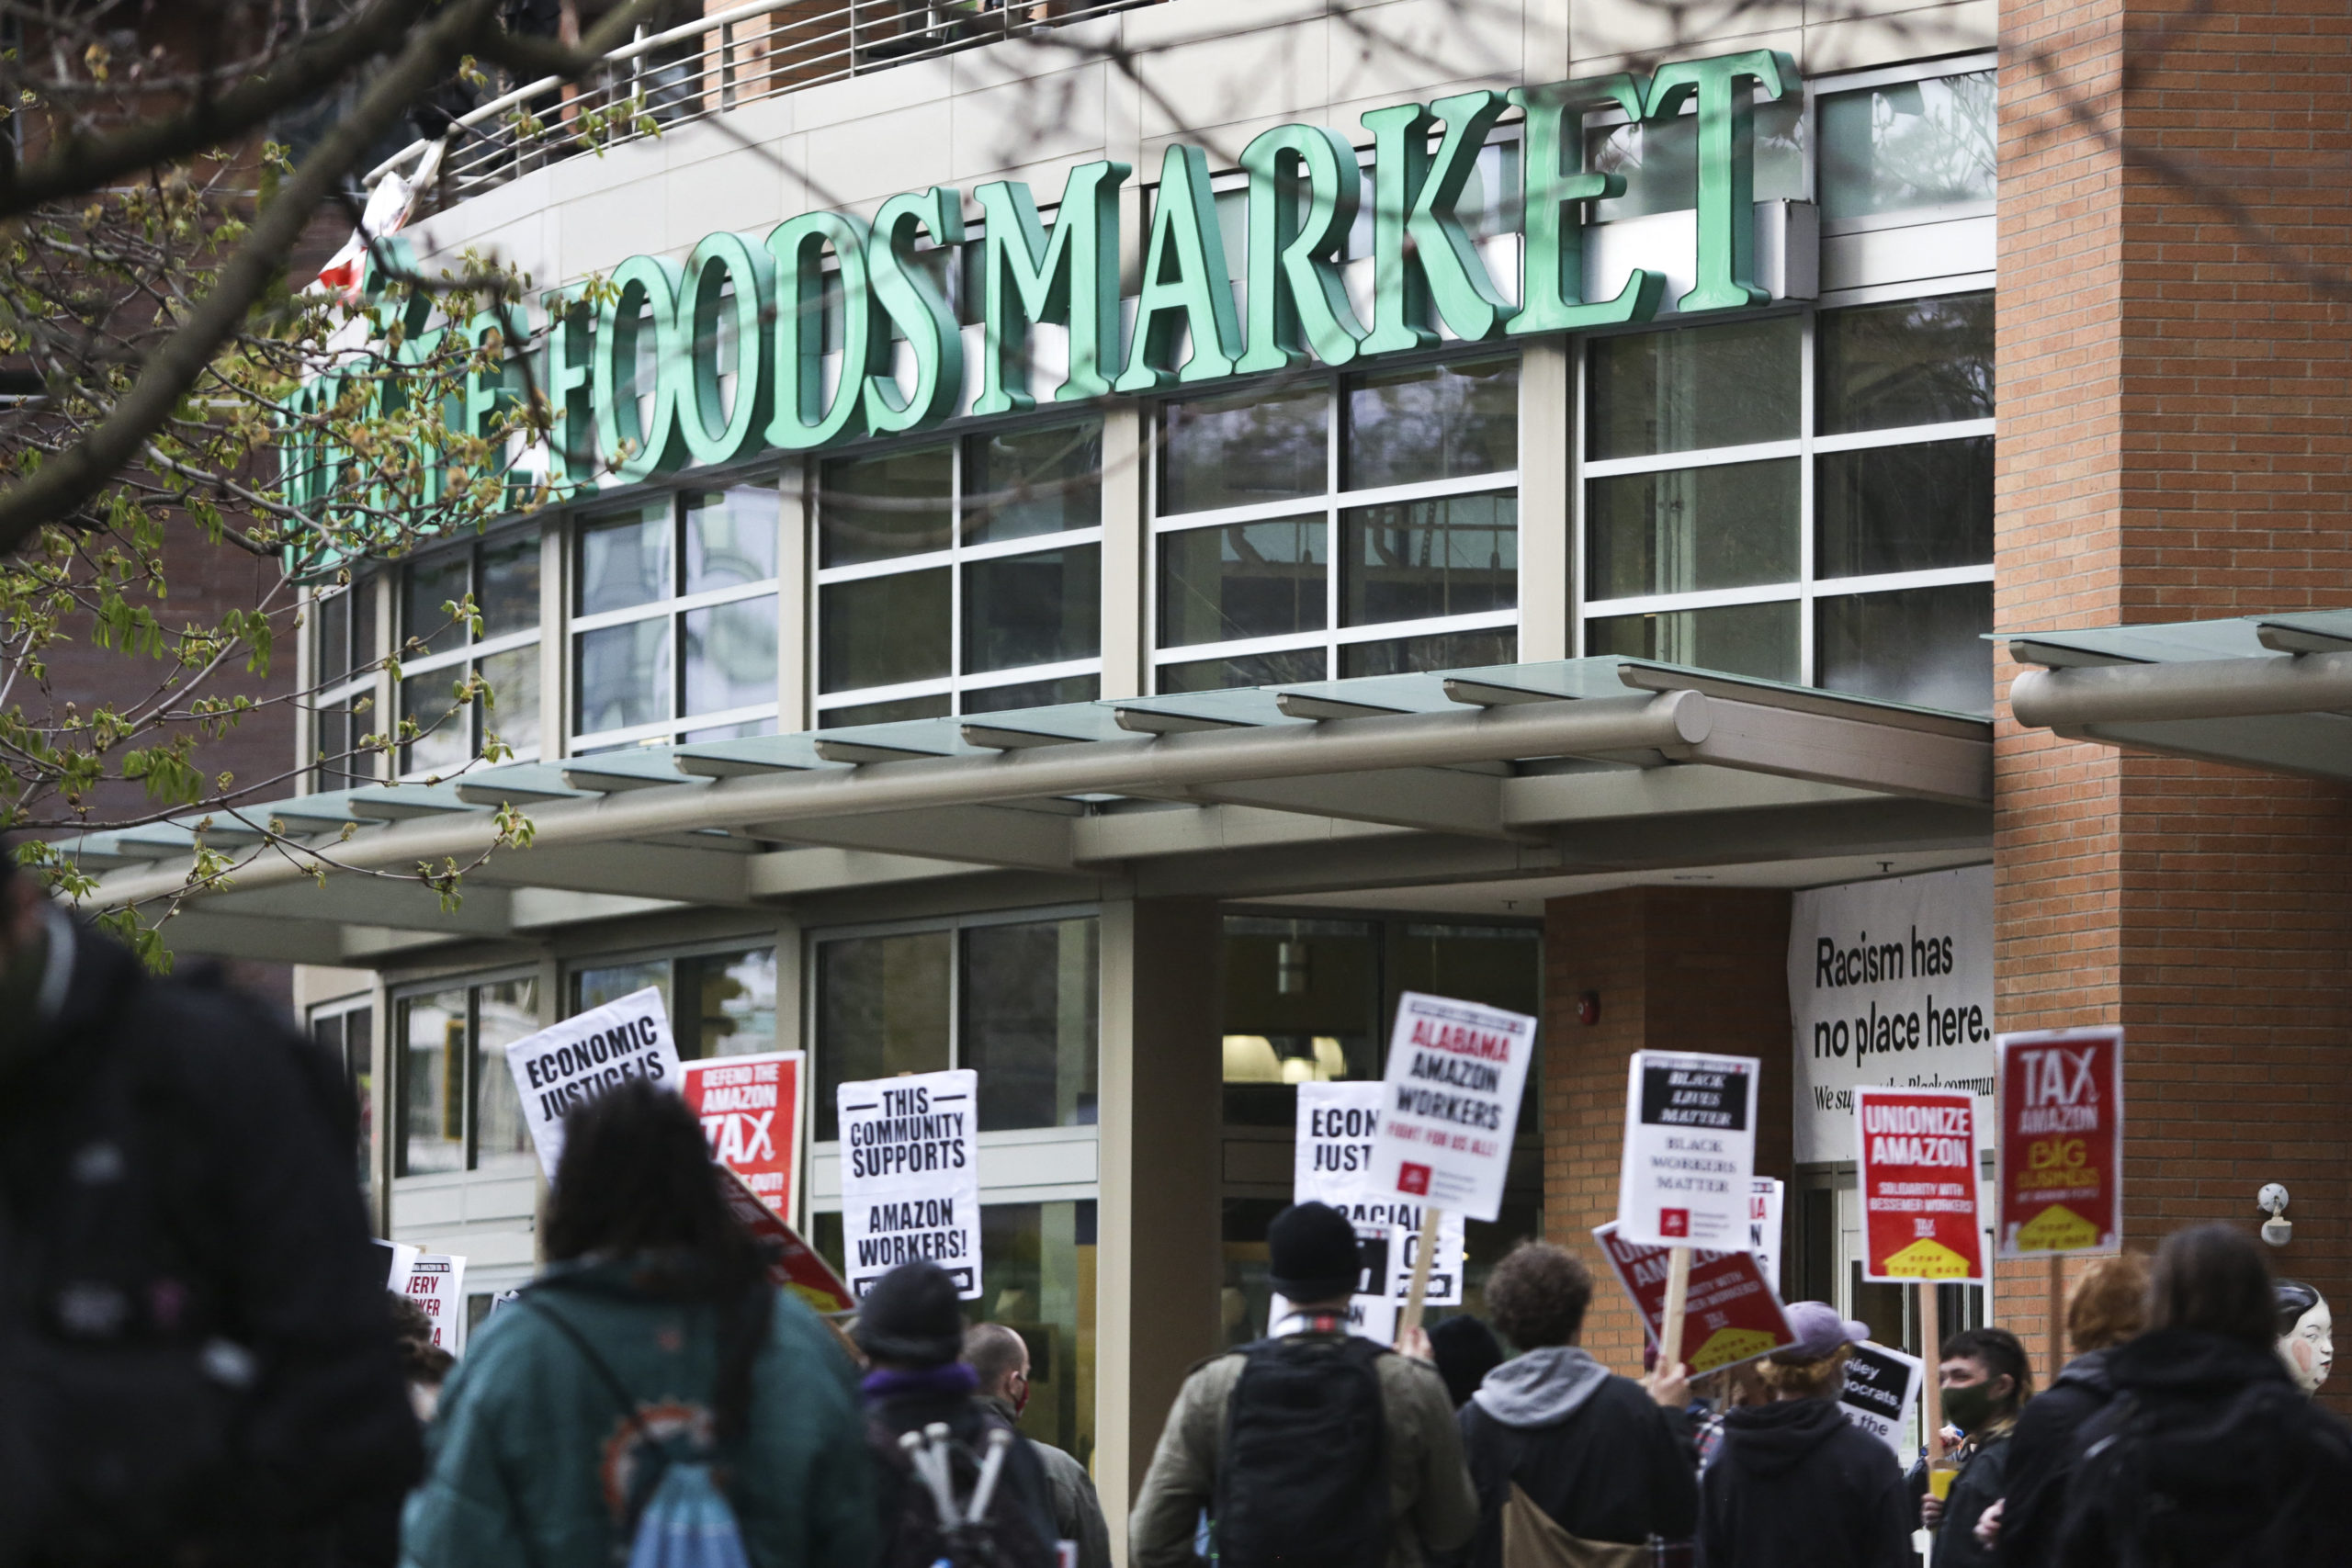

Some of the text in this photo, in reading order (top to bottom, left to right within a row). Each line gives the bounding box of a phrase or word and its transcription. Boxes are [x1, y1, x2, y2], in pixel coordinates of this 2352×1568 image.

[540, 186, 963, 503] FOODS
[972, 49, 1799, 416] MARKET
[1815, 924, 1953, 988] Racism has
[1410, 1019, 1511, 1064] ALABAMA
[1814, 994, 1990, 1068] no place here.
[526, 1015, 658, 1089] ECONOMIC
[701, 1063, 780, 1088] DEFEND THE
[1410, 1052, 1503, 1093] AMAZON
[2020, 1046, 2100, 1107] TAX
[701, 1084, 777, 1113] AMAZON
[882, 1087, 929, 1117] THIS
[1396, 1086, 1503, 1131] WORKERS
[1814, 1085, 1833, 1111] We
[699, 1110, 775, 1164] TAX
[851, 1112, 964, 1147] COMMUNITY
[1864, 1105, 1970, 1136] UNIONIZE
[2018, 1105, 2098, 1134] AMAZON
[853, 1138, 965, 1178] SUPPORTS
[1666, 1137, 1723, 1153] BLACK
[1871, 1136, 1967, 1168] AMAZON
[2029, 1137, 2087, 1170] BIG
[1650, 1156, 1736, 1174] WORKERS
[1656, 1177, 1729, 1193] MATTER
[870, 1198, 953, 1234] AMAZON
[858, 1229, 967, 1267] WORKERS!
